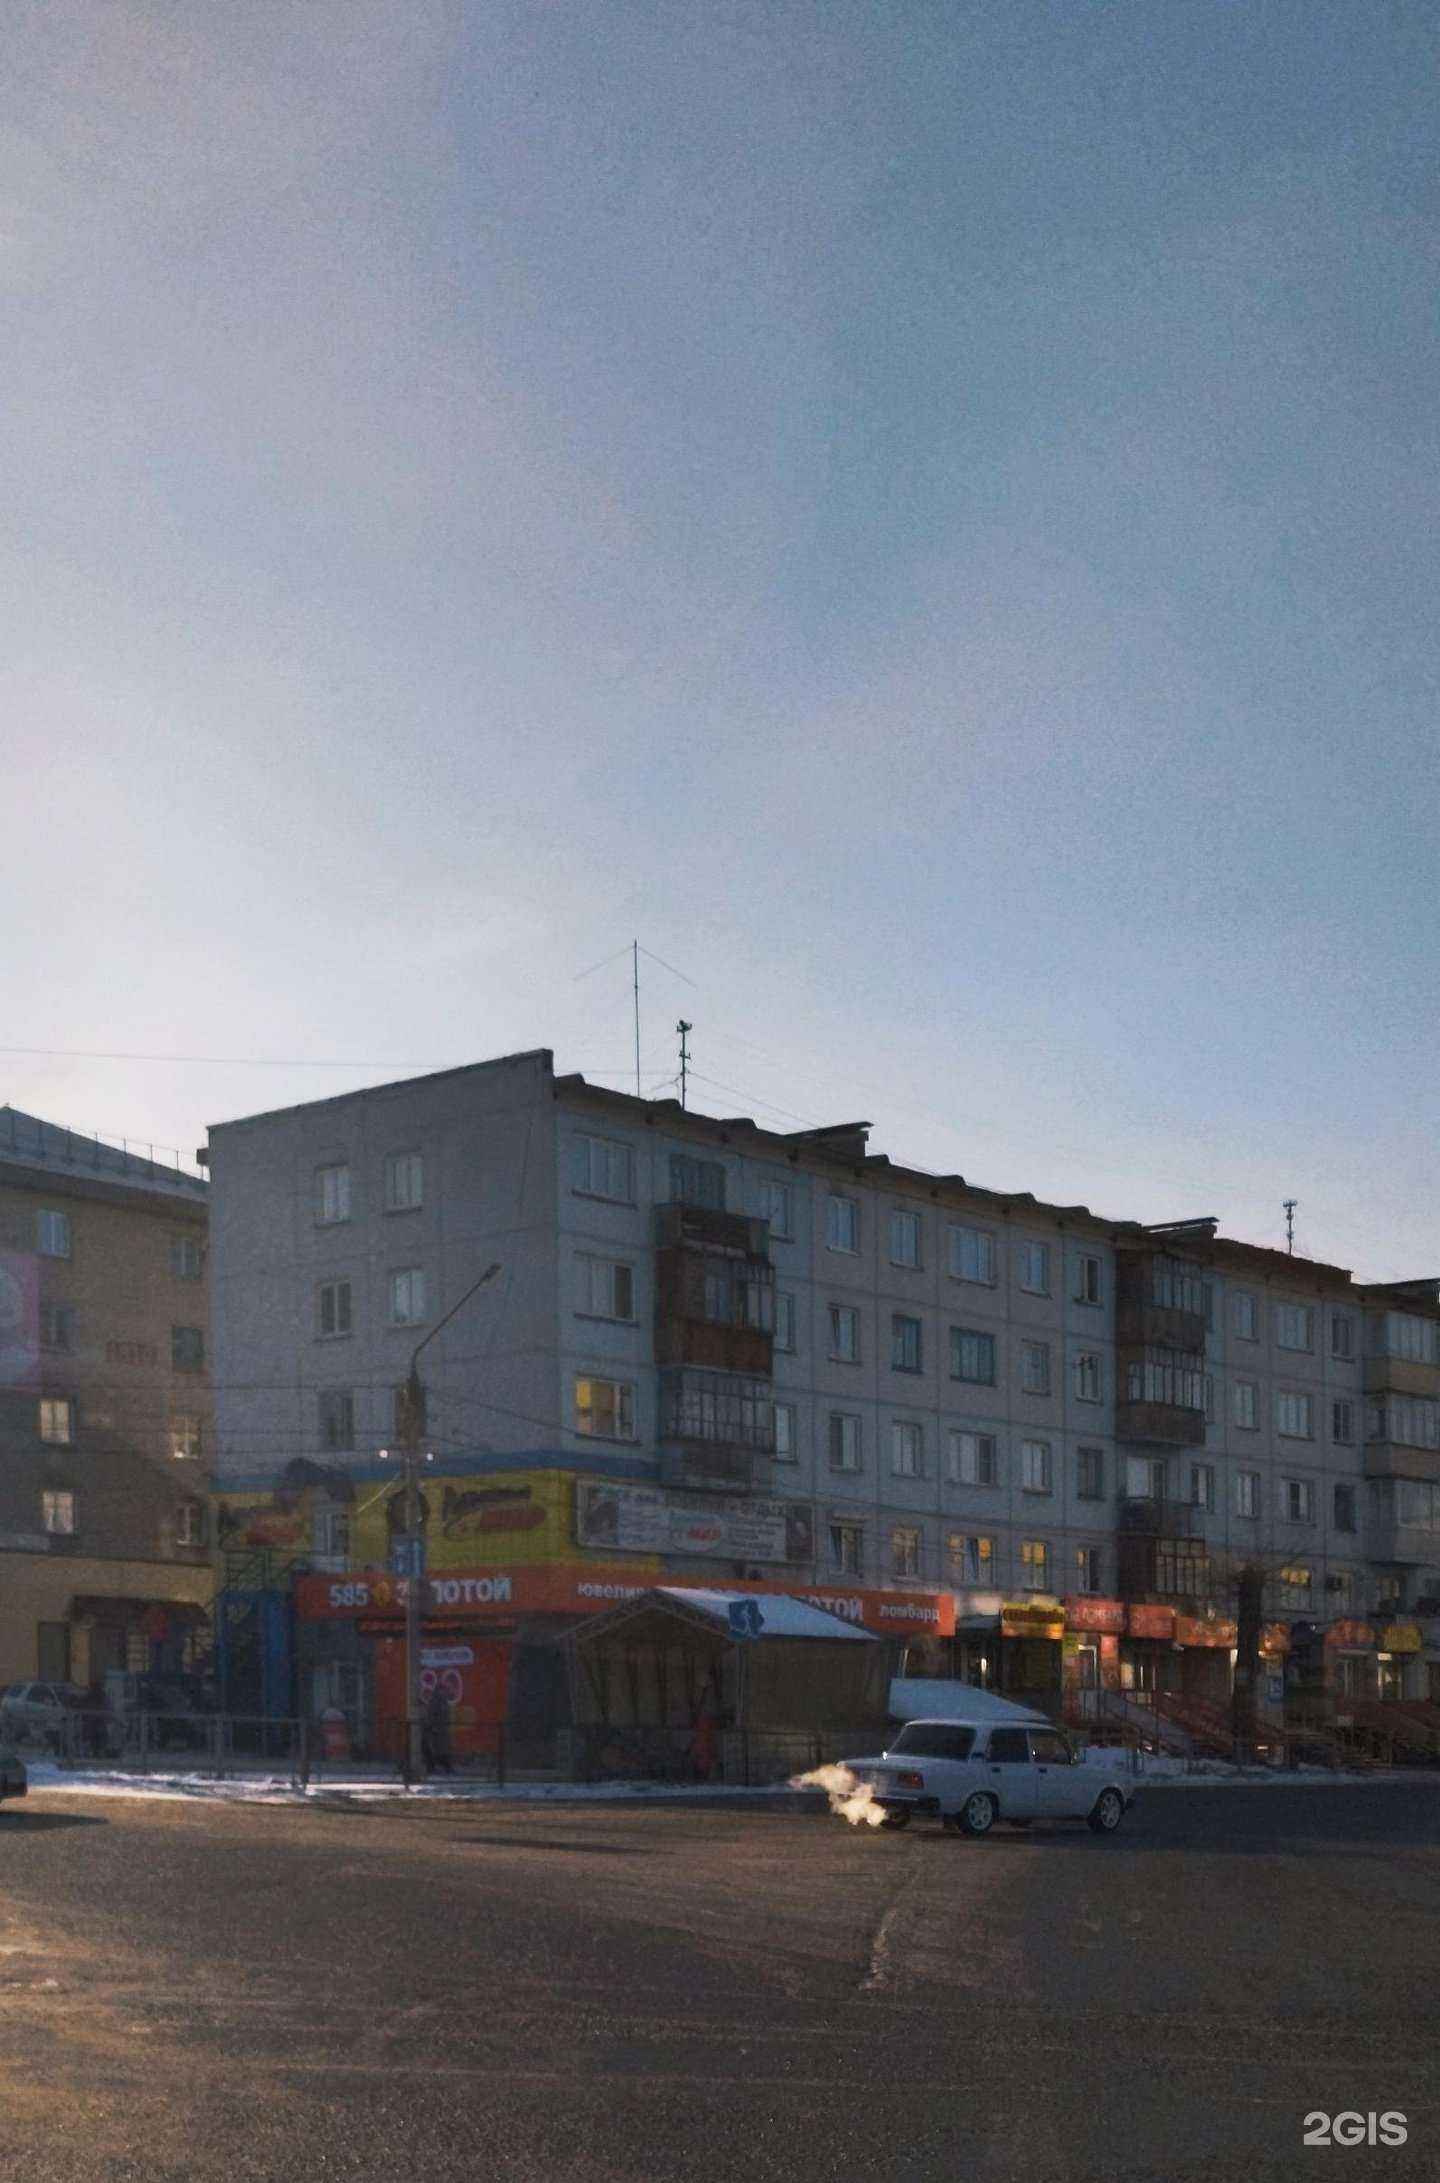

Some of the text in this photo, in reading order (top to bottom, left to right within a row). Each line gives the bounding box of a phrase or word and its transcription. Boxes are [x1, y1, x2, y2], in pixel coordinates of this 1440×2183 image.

[329, 1574, 512, 1607] 585 ЗЛОТОЙ
[880, 1603, 940, 1623] ломбард
